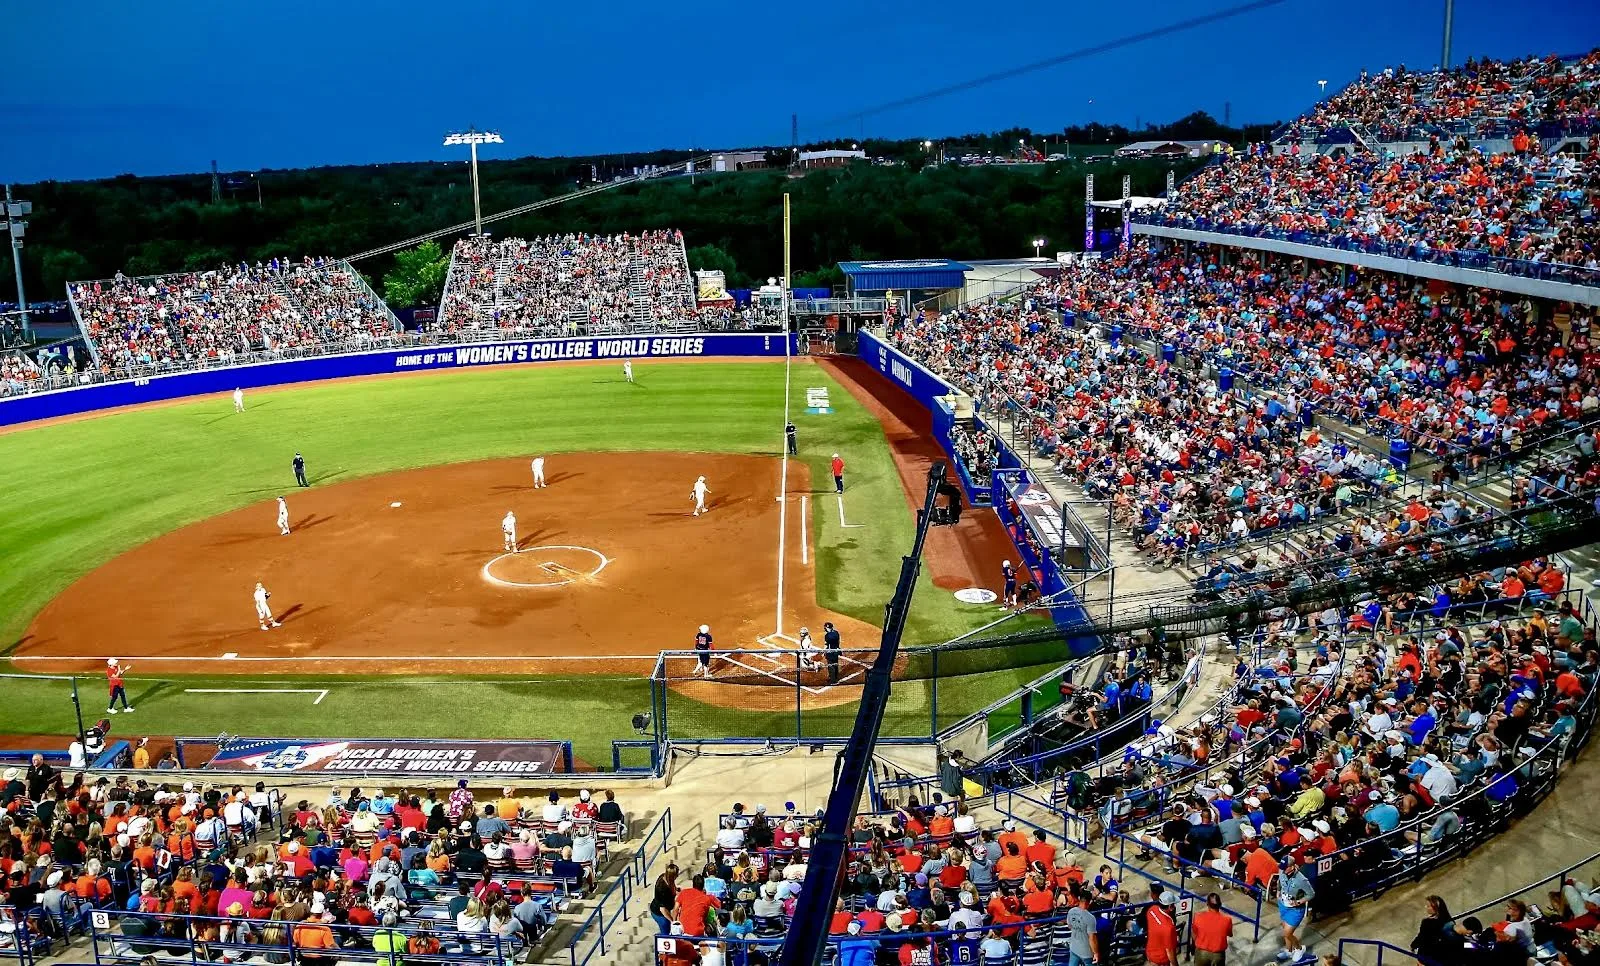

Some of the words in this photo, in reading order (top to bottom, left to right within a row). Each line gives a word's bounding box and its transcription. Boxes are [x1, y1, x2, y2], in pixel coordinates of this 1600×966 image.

[396, 355, 422, 366] HOME
[423, 353, 435, 364] OF
[437, 352, 453, 362] THE
[456, 344, 528, 364] WOMEN'S
[531, 341, 593, 360] COLLEGE
[598, 339, 649, 357] WORLD
[651, 338, 705, 355] SERIES
[337, 748, 388, 760] NCAA
[387, 748, 477, 760] WOMEN'S
[323, 759, 406, 770] COLLEGE
[404, 760, 473, 771] WORLD
[472, 761, 544, 772] SERIES
[1320, 860, 1331, 872] 10
[1181, 901, 1188, 911] 9
[96, 914, 105, 924] 8
[663, 940, 671, 951] 9
[958, 946, 971, 963] 6
